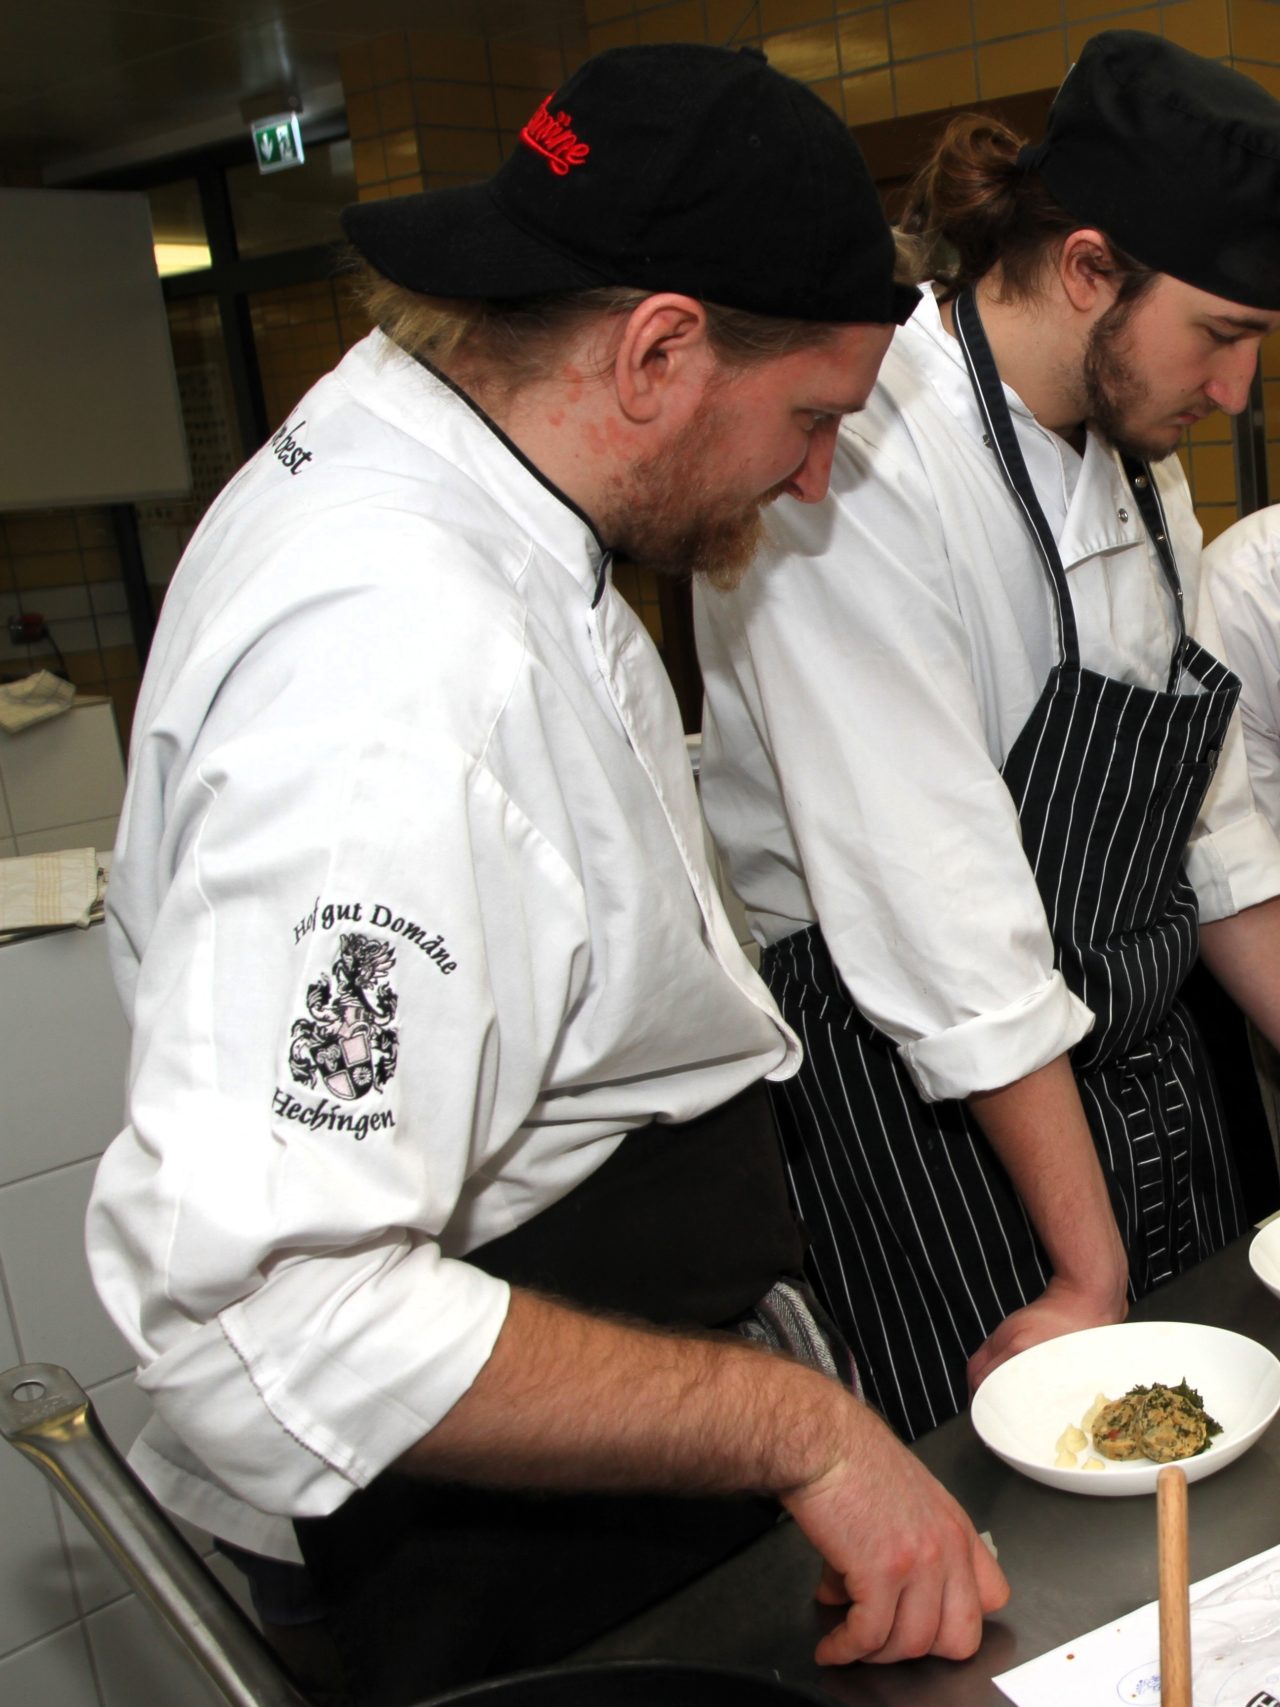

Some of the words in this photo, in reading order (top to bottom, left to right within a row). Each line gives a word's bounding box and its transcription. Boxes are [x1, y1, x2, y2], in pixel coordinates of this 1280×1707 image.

[274, 420, 313, 476] best
[293, 896, 320, 945] Hof
[321, 902, 363, 930] gut
[370, 904, 458, 976] Domäne
[271, 1087, 396, 1141] Hechingen
